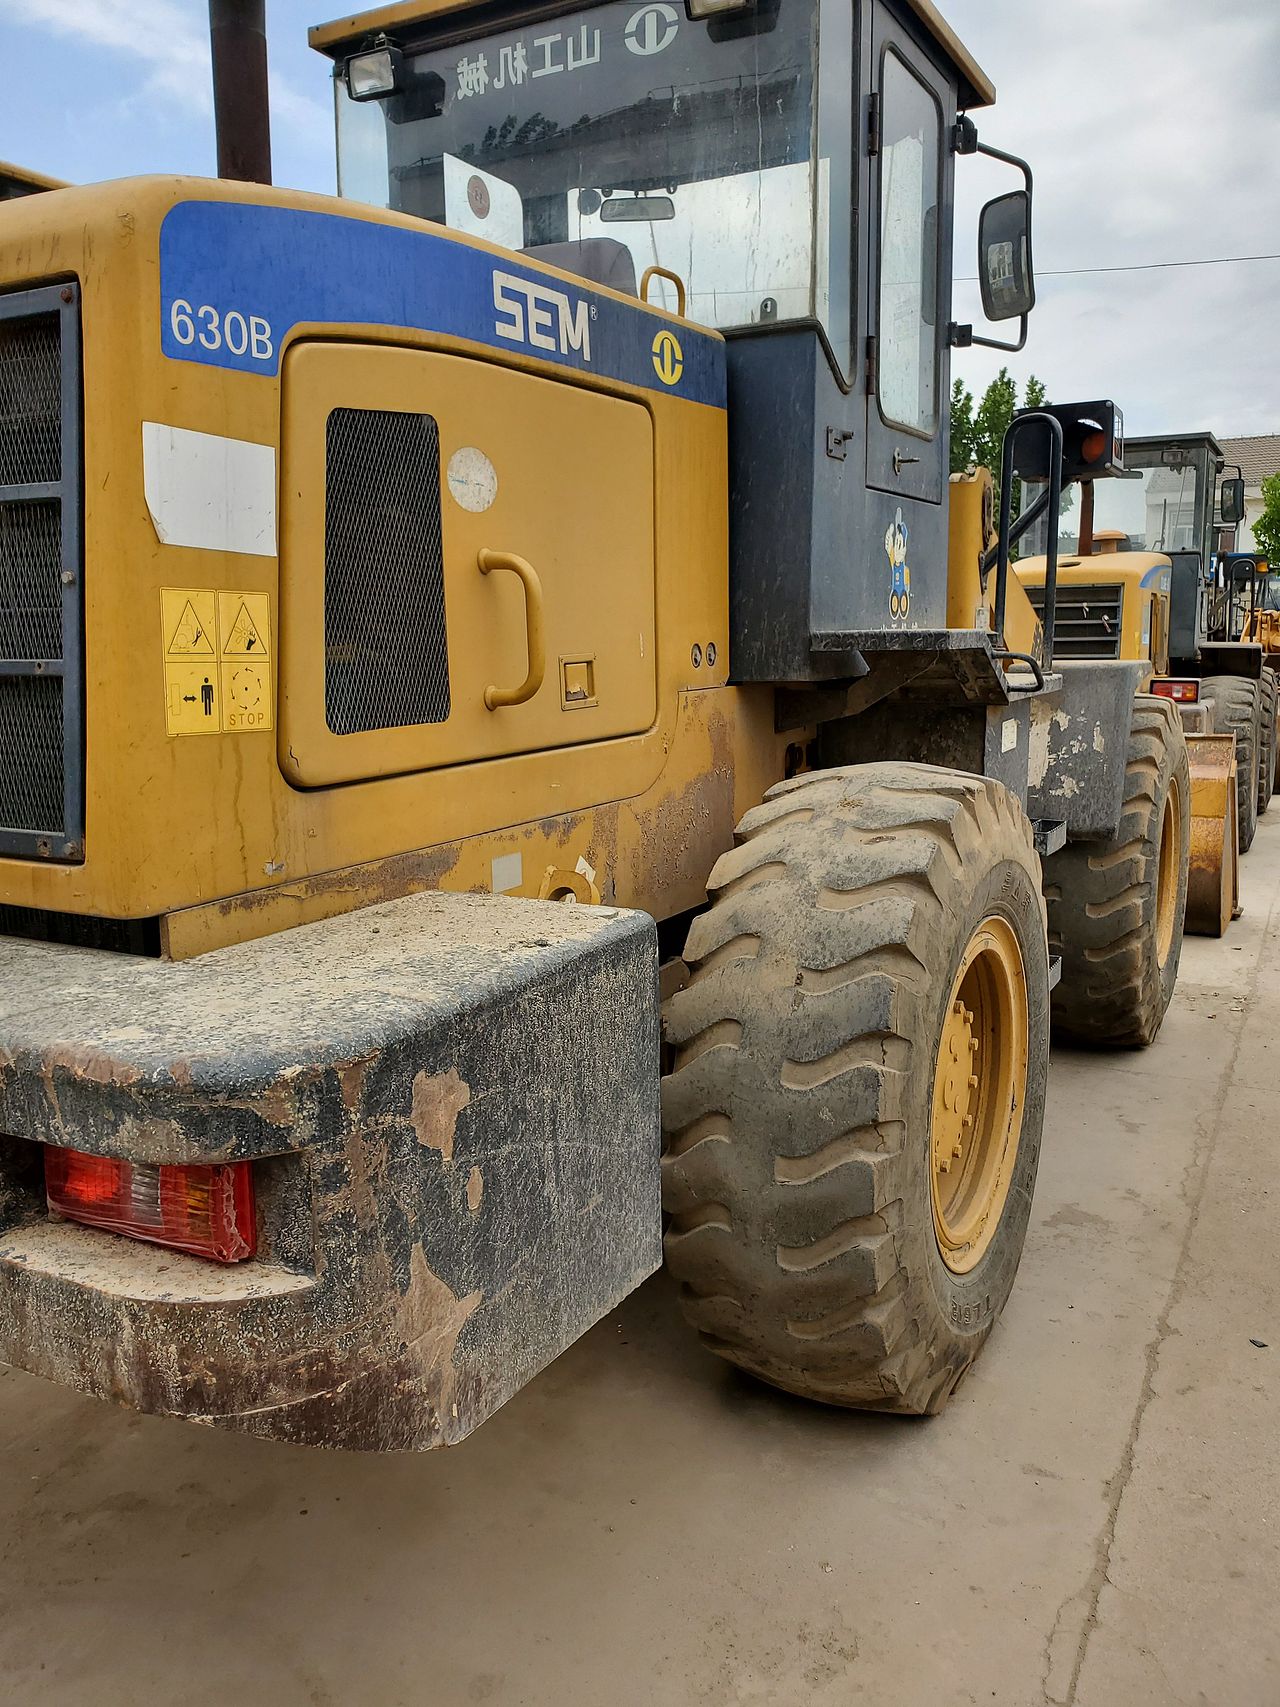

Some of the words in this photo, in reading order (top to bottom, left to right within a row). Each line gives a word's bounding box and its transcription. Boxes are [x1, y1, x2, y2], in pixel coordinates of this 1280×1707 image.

[171, 299, 273, 359] 630B
[493, 270, 590, 361] SEM
[229, 712, 264, 726] STOP
